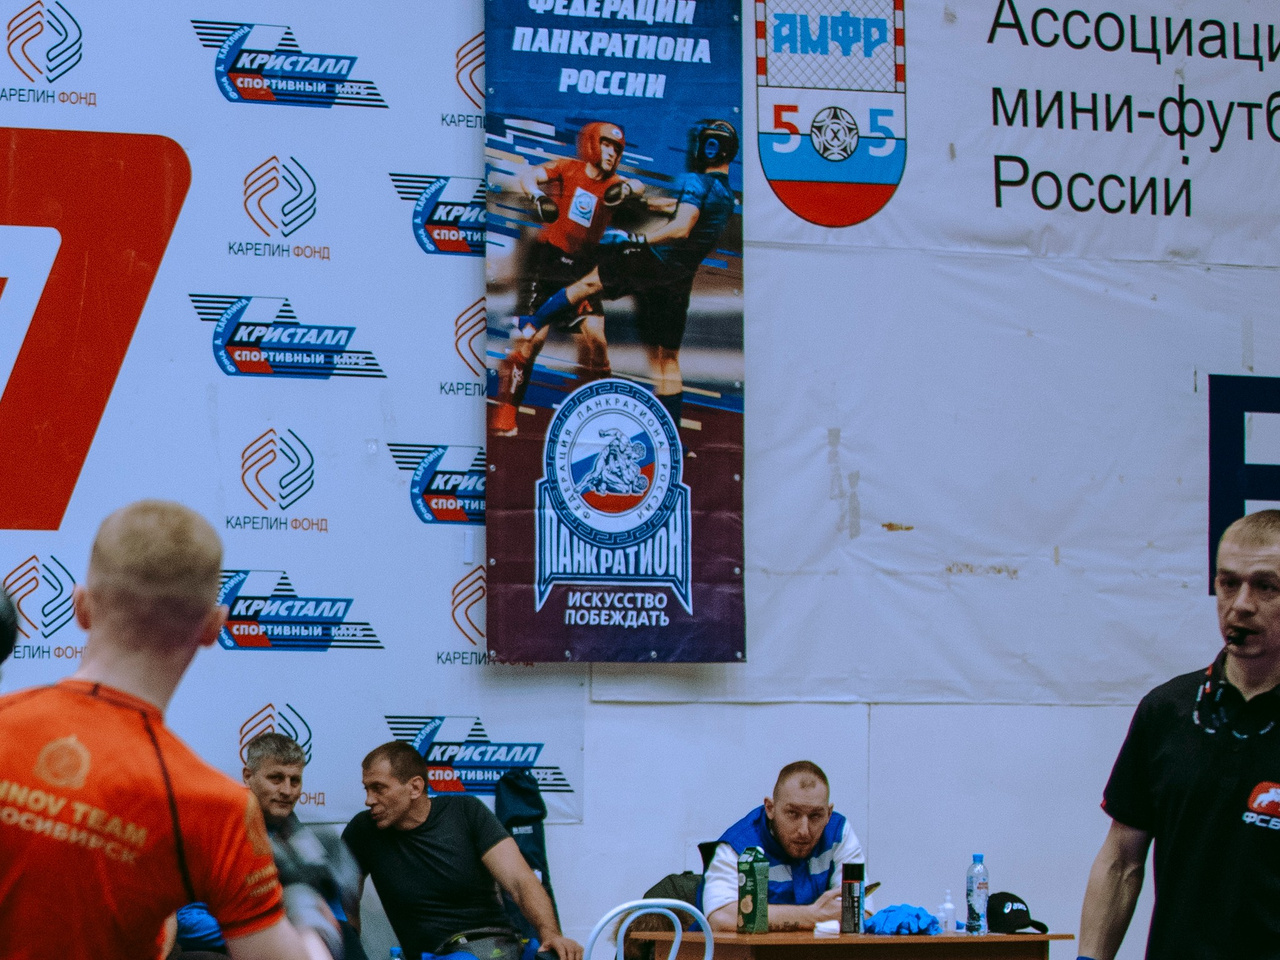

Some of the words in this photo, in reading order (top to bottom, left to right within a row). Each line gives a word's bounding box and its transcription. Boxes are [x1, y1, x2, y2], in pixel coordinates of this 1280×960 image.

[512, 26, 711, 64] ПАНКРАТИОНА
[236, 52, 352, 75] КРИСТАЛЛ
[236, 77, 327, 93] СПОРТИВНЫЙ
[558, 67, 667, 99] РОССИИ
[58, 91, 97, 107] ФОНД
[441, 113, 486, 130] КАРЕЛ
[772, 104, 802, 154] 5
[868, 108, 897, 157] 5
[228, 241, 290, 257] КАРЕЛИН
[293, 245, 331, 261] ФОНД
[234, 325, 349, 345] КРИСТАЛЛ
[234, 349, 325, 365] СПОРТИВНЫЙ
[558, 428, 591, 520] ФЕДЕРАЦИЯ
[576, 397, 665, 449] ПАНКРАТИОНА
[637, 463, 668, 520] РОССИИ
[226, 515, 288, 530] КАРЕЛИН
[290, 517, 328, 533] ФОНД
[544, 487, 683, 581] ПАНКРАТИОН
[232, 599, 346, 617] КРИСТАЛЛ
[567, 591, 668, 609] ИСКУССТВО
[564, 609, 670, 629] ПОБЕЖДАТЬ
[232, 623, 323, 637] СПОРТИВНЫЙ
[53, 646, 86, 659] ФОН
[428, 745, 537, 762] КРИСТАЛЛ
[72, 802, 148, 847] TEAM
